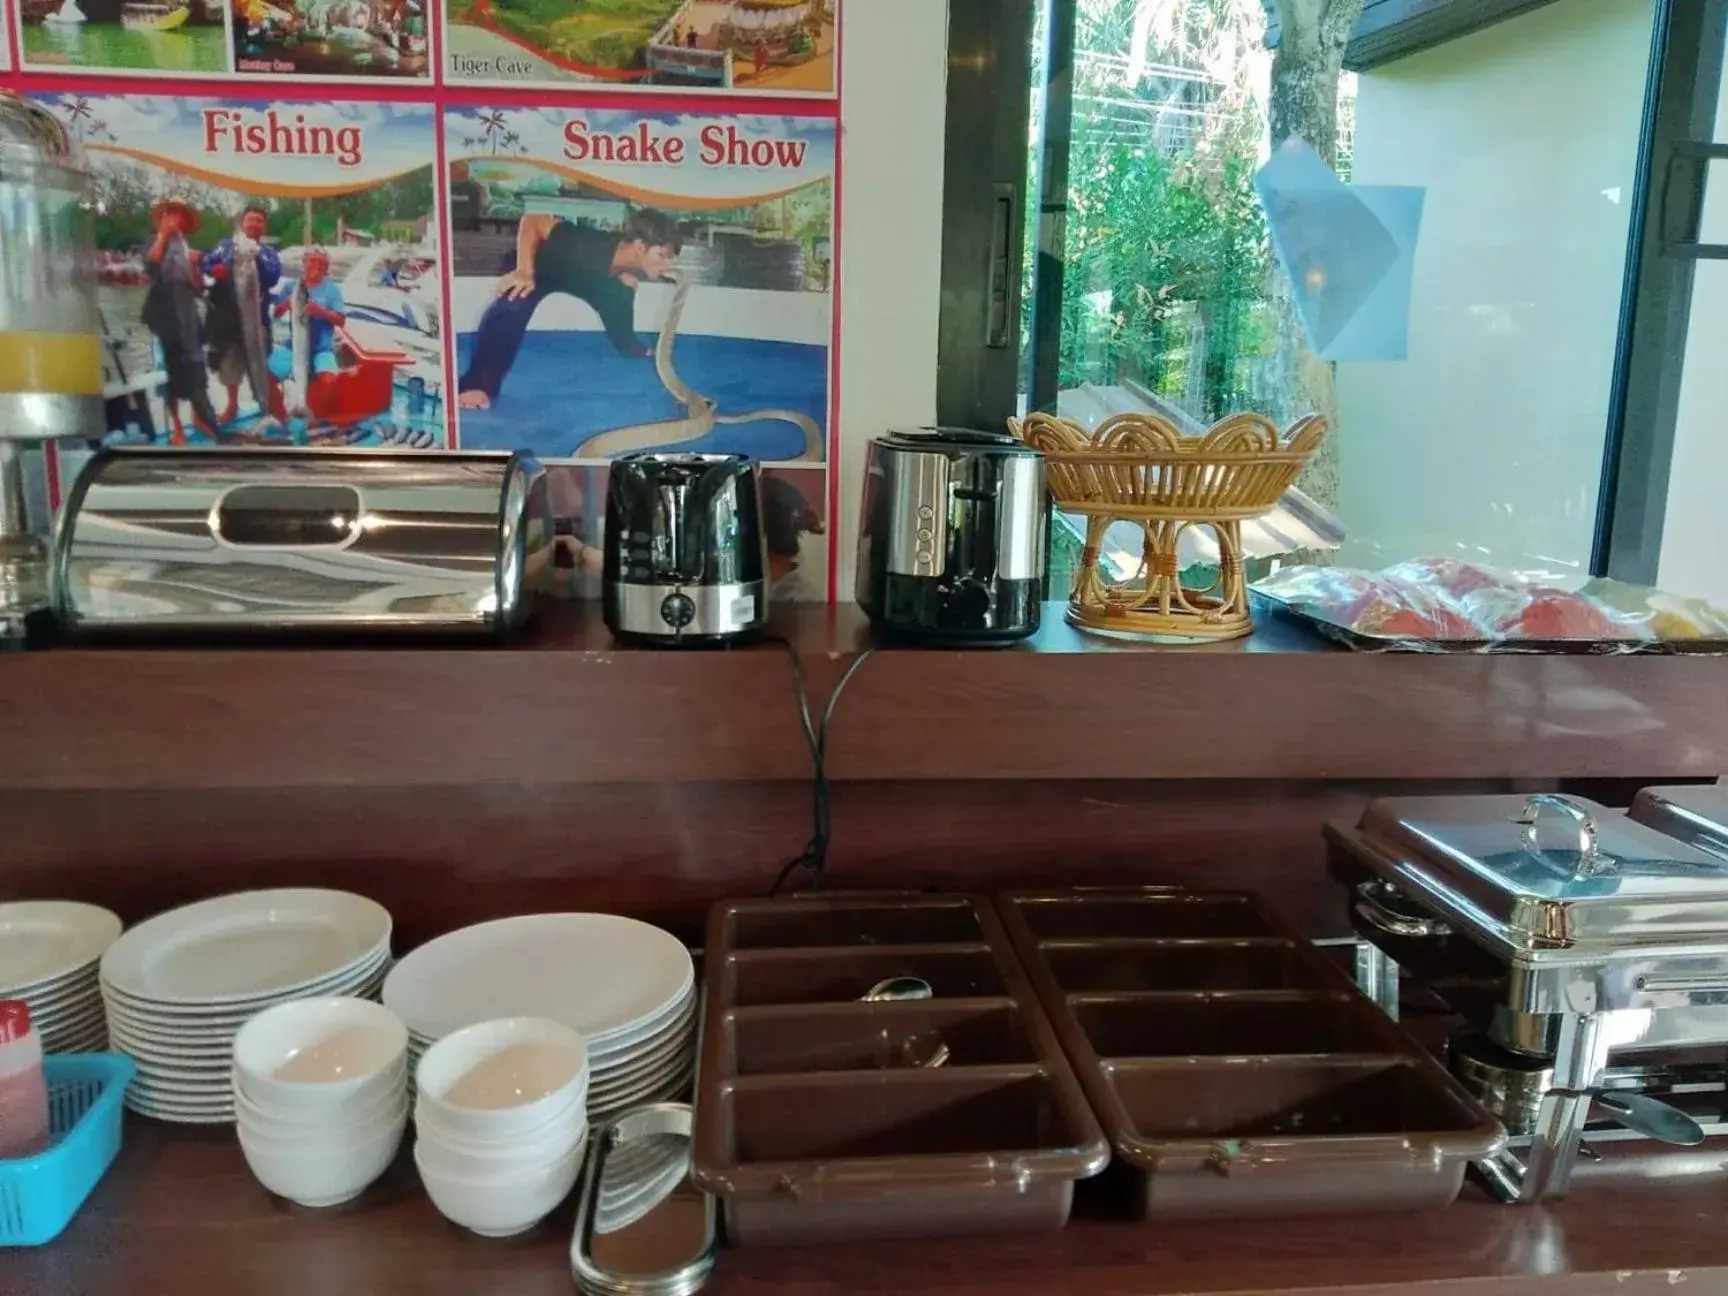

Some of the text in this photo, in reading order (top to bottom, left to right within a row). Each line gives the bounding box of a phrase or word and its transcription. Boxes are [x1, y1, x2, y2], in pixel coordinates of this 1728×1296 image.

[450, 54, 532, 77] Tiger Cave
[203, 110, 362, 165] Fishing
[563, 119, 807, 168] Snake Show
